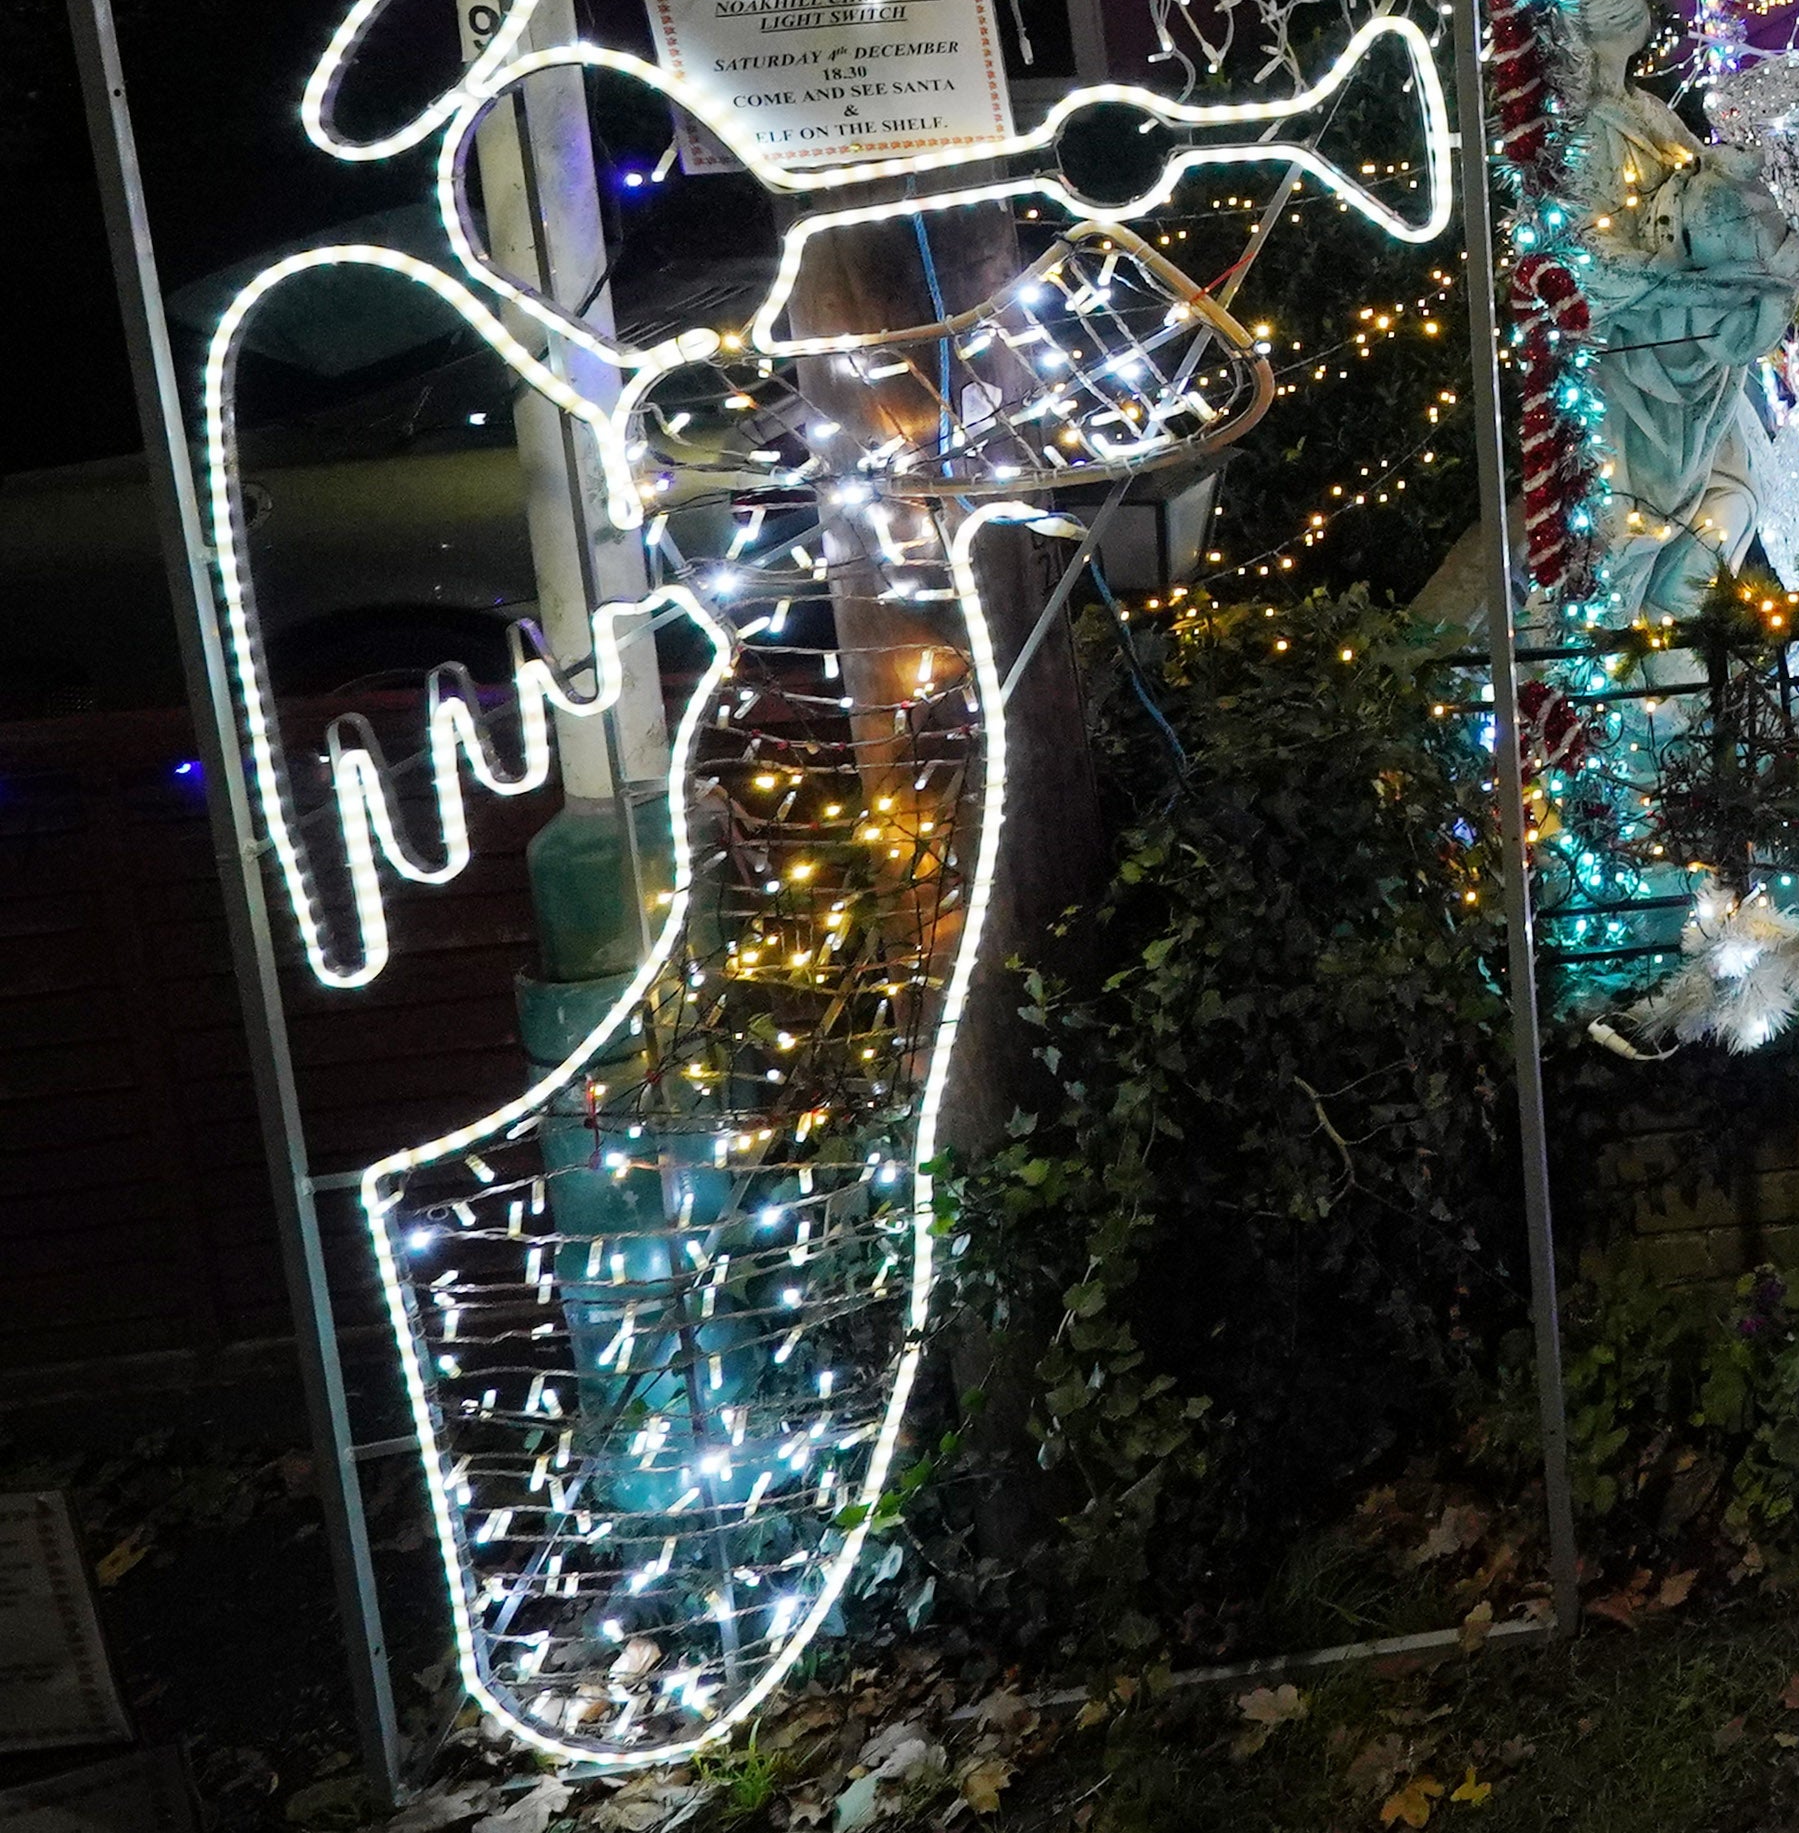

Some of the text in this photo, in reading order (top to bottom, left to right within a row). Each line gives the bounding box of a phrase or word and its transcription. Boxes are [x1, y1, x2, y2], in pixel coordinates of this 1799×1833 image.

[760, 4, 906, 32] LIGHT SWITCH
[714, 50, 822, 72] SATURDAY
[853, 40, 959, 60] DECEMBER
[823, 65, 868, 81] 18.30
[733, 79, 955, 108] COME AND SEE SANTA
[843, 104, 860, 117] &
[756, 116, 949, 144] ELF ON THE SHELF.
